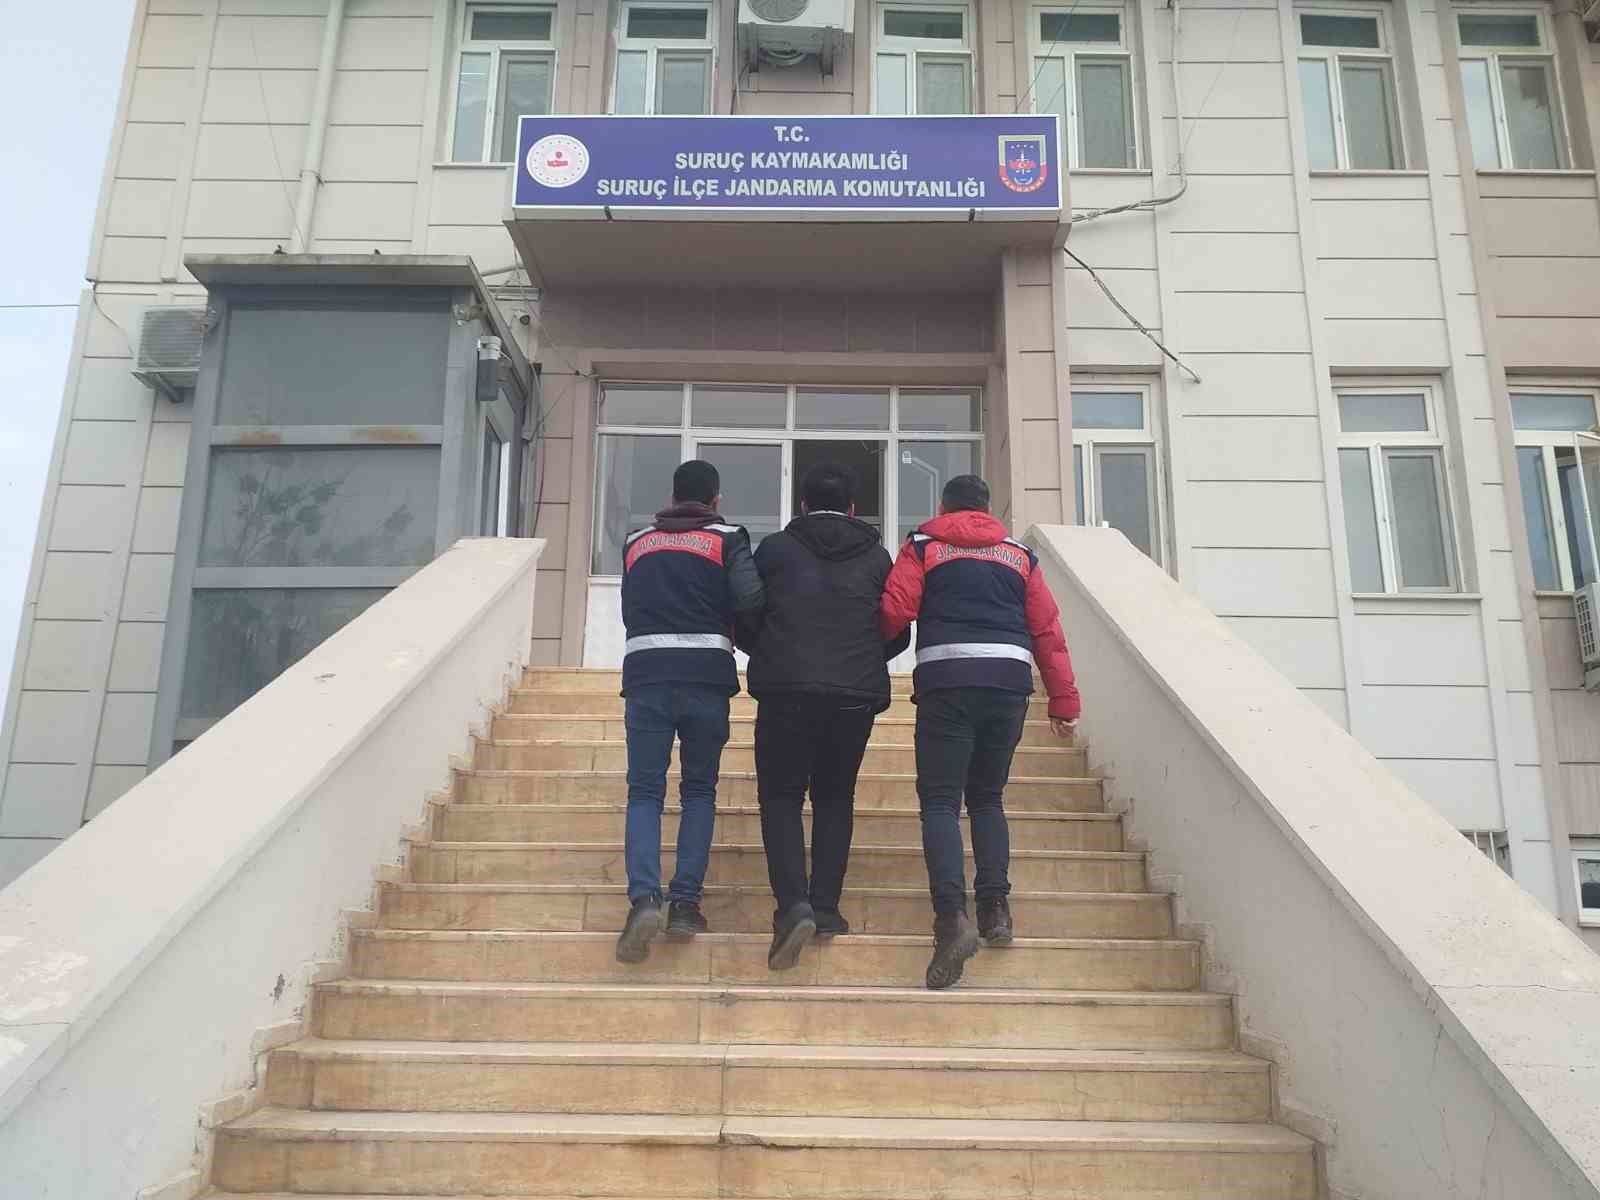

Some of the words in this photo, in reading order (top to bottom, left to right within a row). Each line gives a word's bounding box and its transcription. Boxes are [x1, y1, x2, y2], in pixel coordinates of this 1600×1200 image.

[774, 126, 810, 142] T.C.
[675, 152, 744, 173] SURUÇ
[751, 150, 908, 170] KAYMAKAMLIĞI
[597, 179, 667, 200] SURUÇ
[673, 176, 718, 200] İLÇE
[724, 179, 836, 197] JANDARMA
[844, 177, 985, 198] KOMUTANLIĞI
